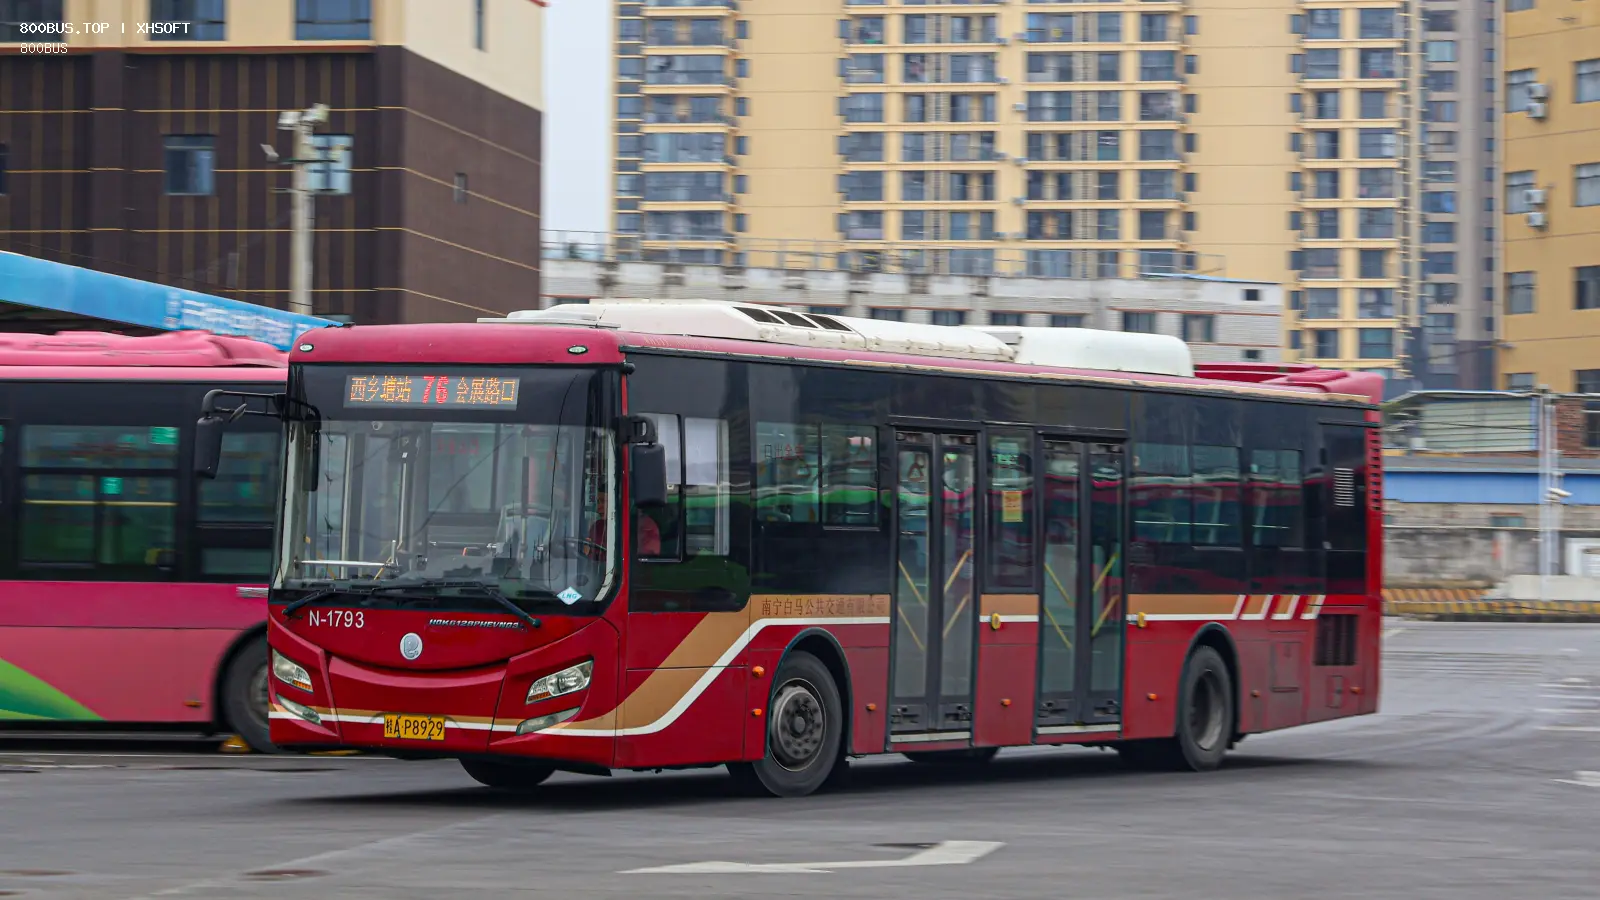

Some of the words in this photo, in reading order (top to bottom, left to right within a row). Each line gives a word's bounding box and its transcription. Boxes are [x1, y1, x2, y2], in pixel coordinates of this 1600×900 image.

[350, 375, 412, 403] 西乡塘站
[422, 375, 449, 404] 76
[456, 376, 516, 404] 会展路口
[561, 592, 578, 600] LNG
[309, 609, 365, 629] N-1793
